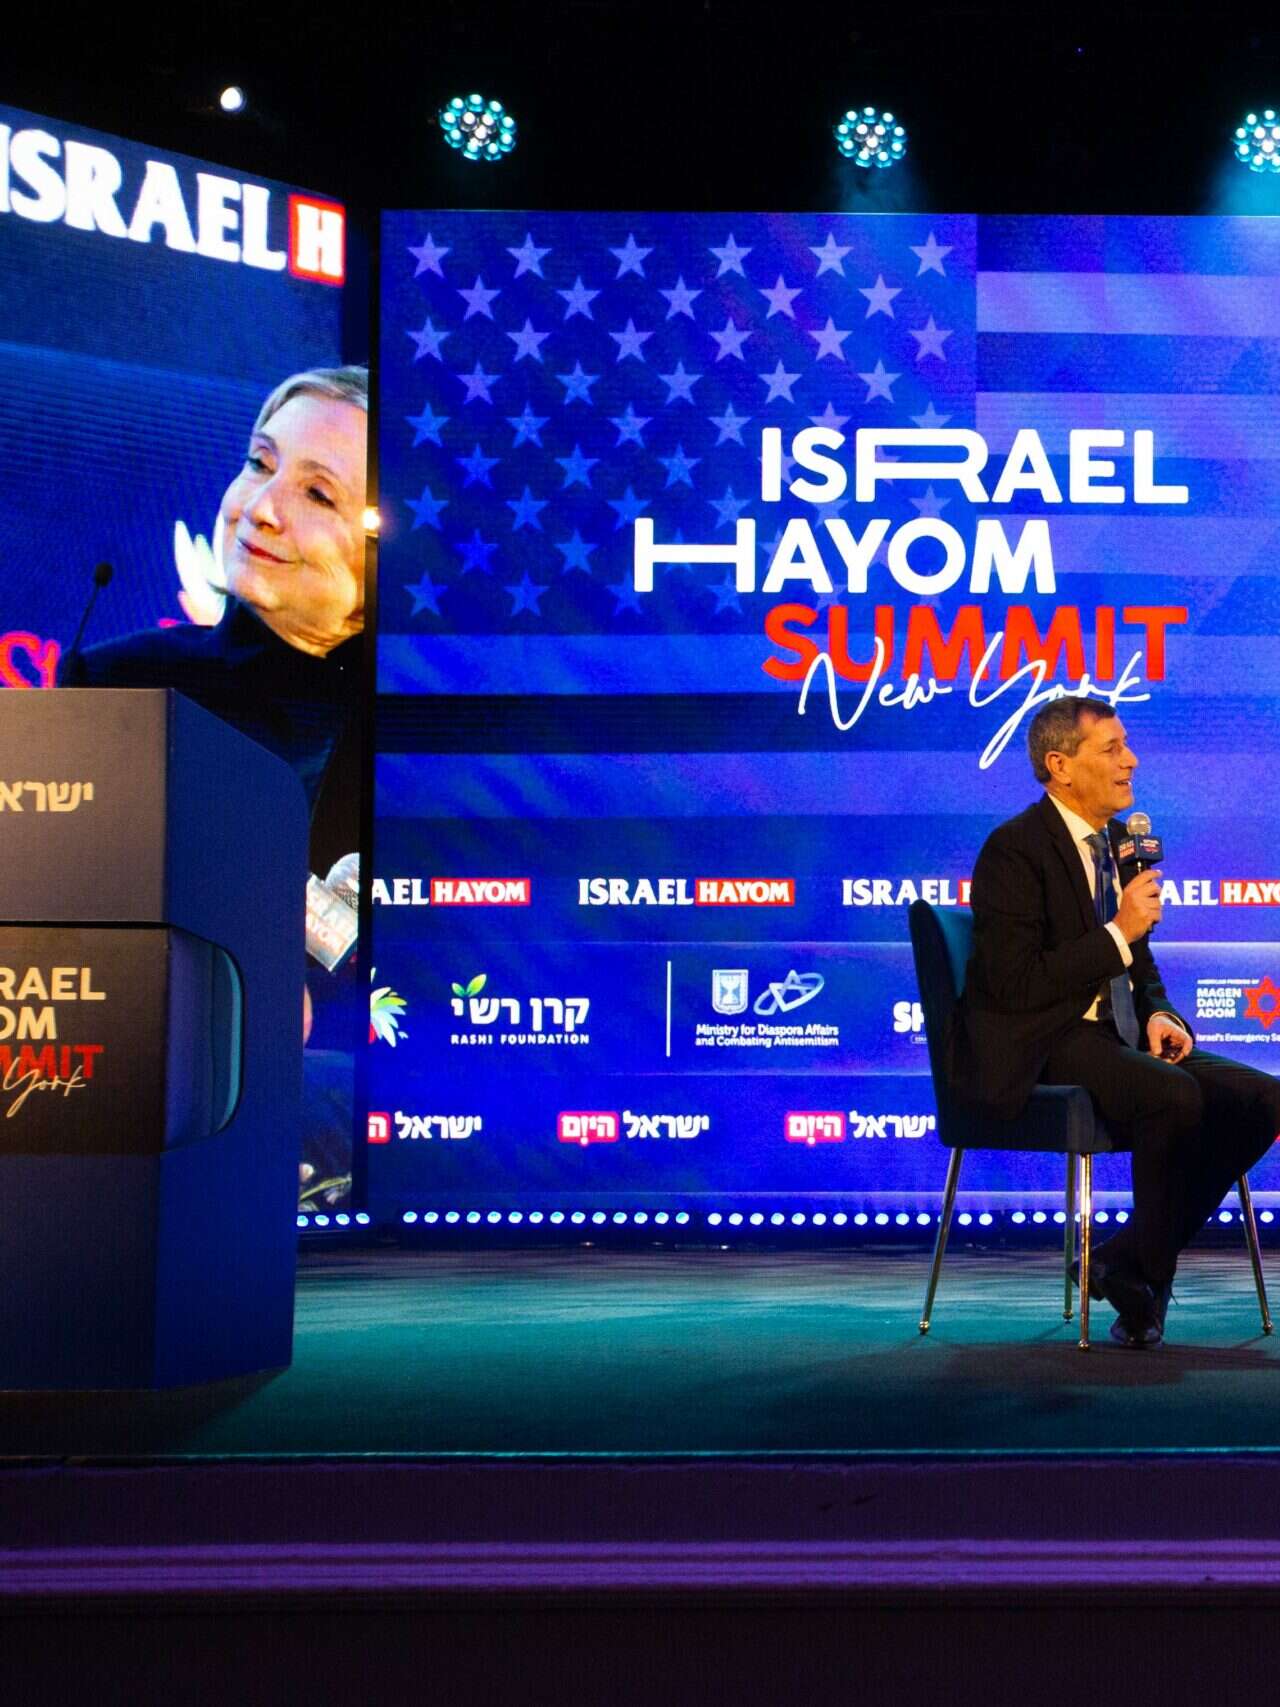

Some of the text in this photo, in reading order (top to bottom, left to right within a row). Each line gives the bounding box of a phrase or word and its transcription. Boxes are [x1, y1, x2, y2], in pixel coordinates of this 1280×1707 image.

[761, 426, 1189, 504] ISRAEL
[634, 517, 1057, 595] HAYOM
[761, 602, 1189, 682] SUMMIT
[798, 631, 1151, 770] New York
[0, 780, 95, 812] ישרא
[372, 878, 527, 905] AEL HAYOM
[578, 877, 790, 906] ISRAEL HAYOM
[842, 878, 957, 906] ISRAEL
[1159, 879, 1219, 906] AEL
[1196, 988, 1242, 998] MAGEN
[1196, 998, 1236, 1008] DAVID
[450, 997, 590, 1033] קרן רשי
[1196, 1008, 1236, 1018] ADOM
[450, 1034, 590, 1045] RASHI FOUNDATION
[695, 1023, 839, 1038] Ministry for Diaspora Affairs
[695, 1037, 839, 1049] and Combating Antisemitism
[394, 1110, 482, 1140] ישראל
[622, 1110, 710, 1139] ישראל
[849, 1110, 937, 1139] ישראל
